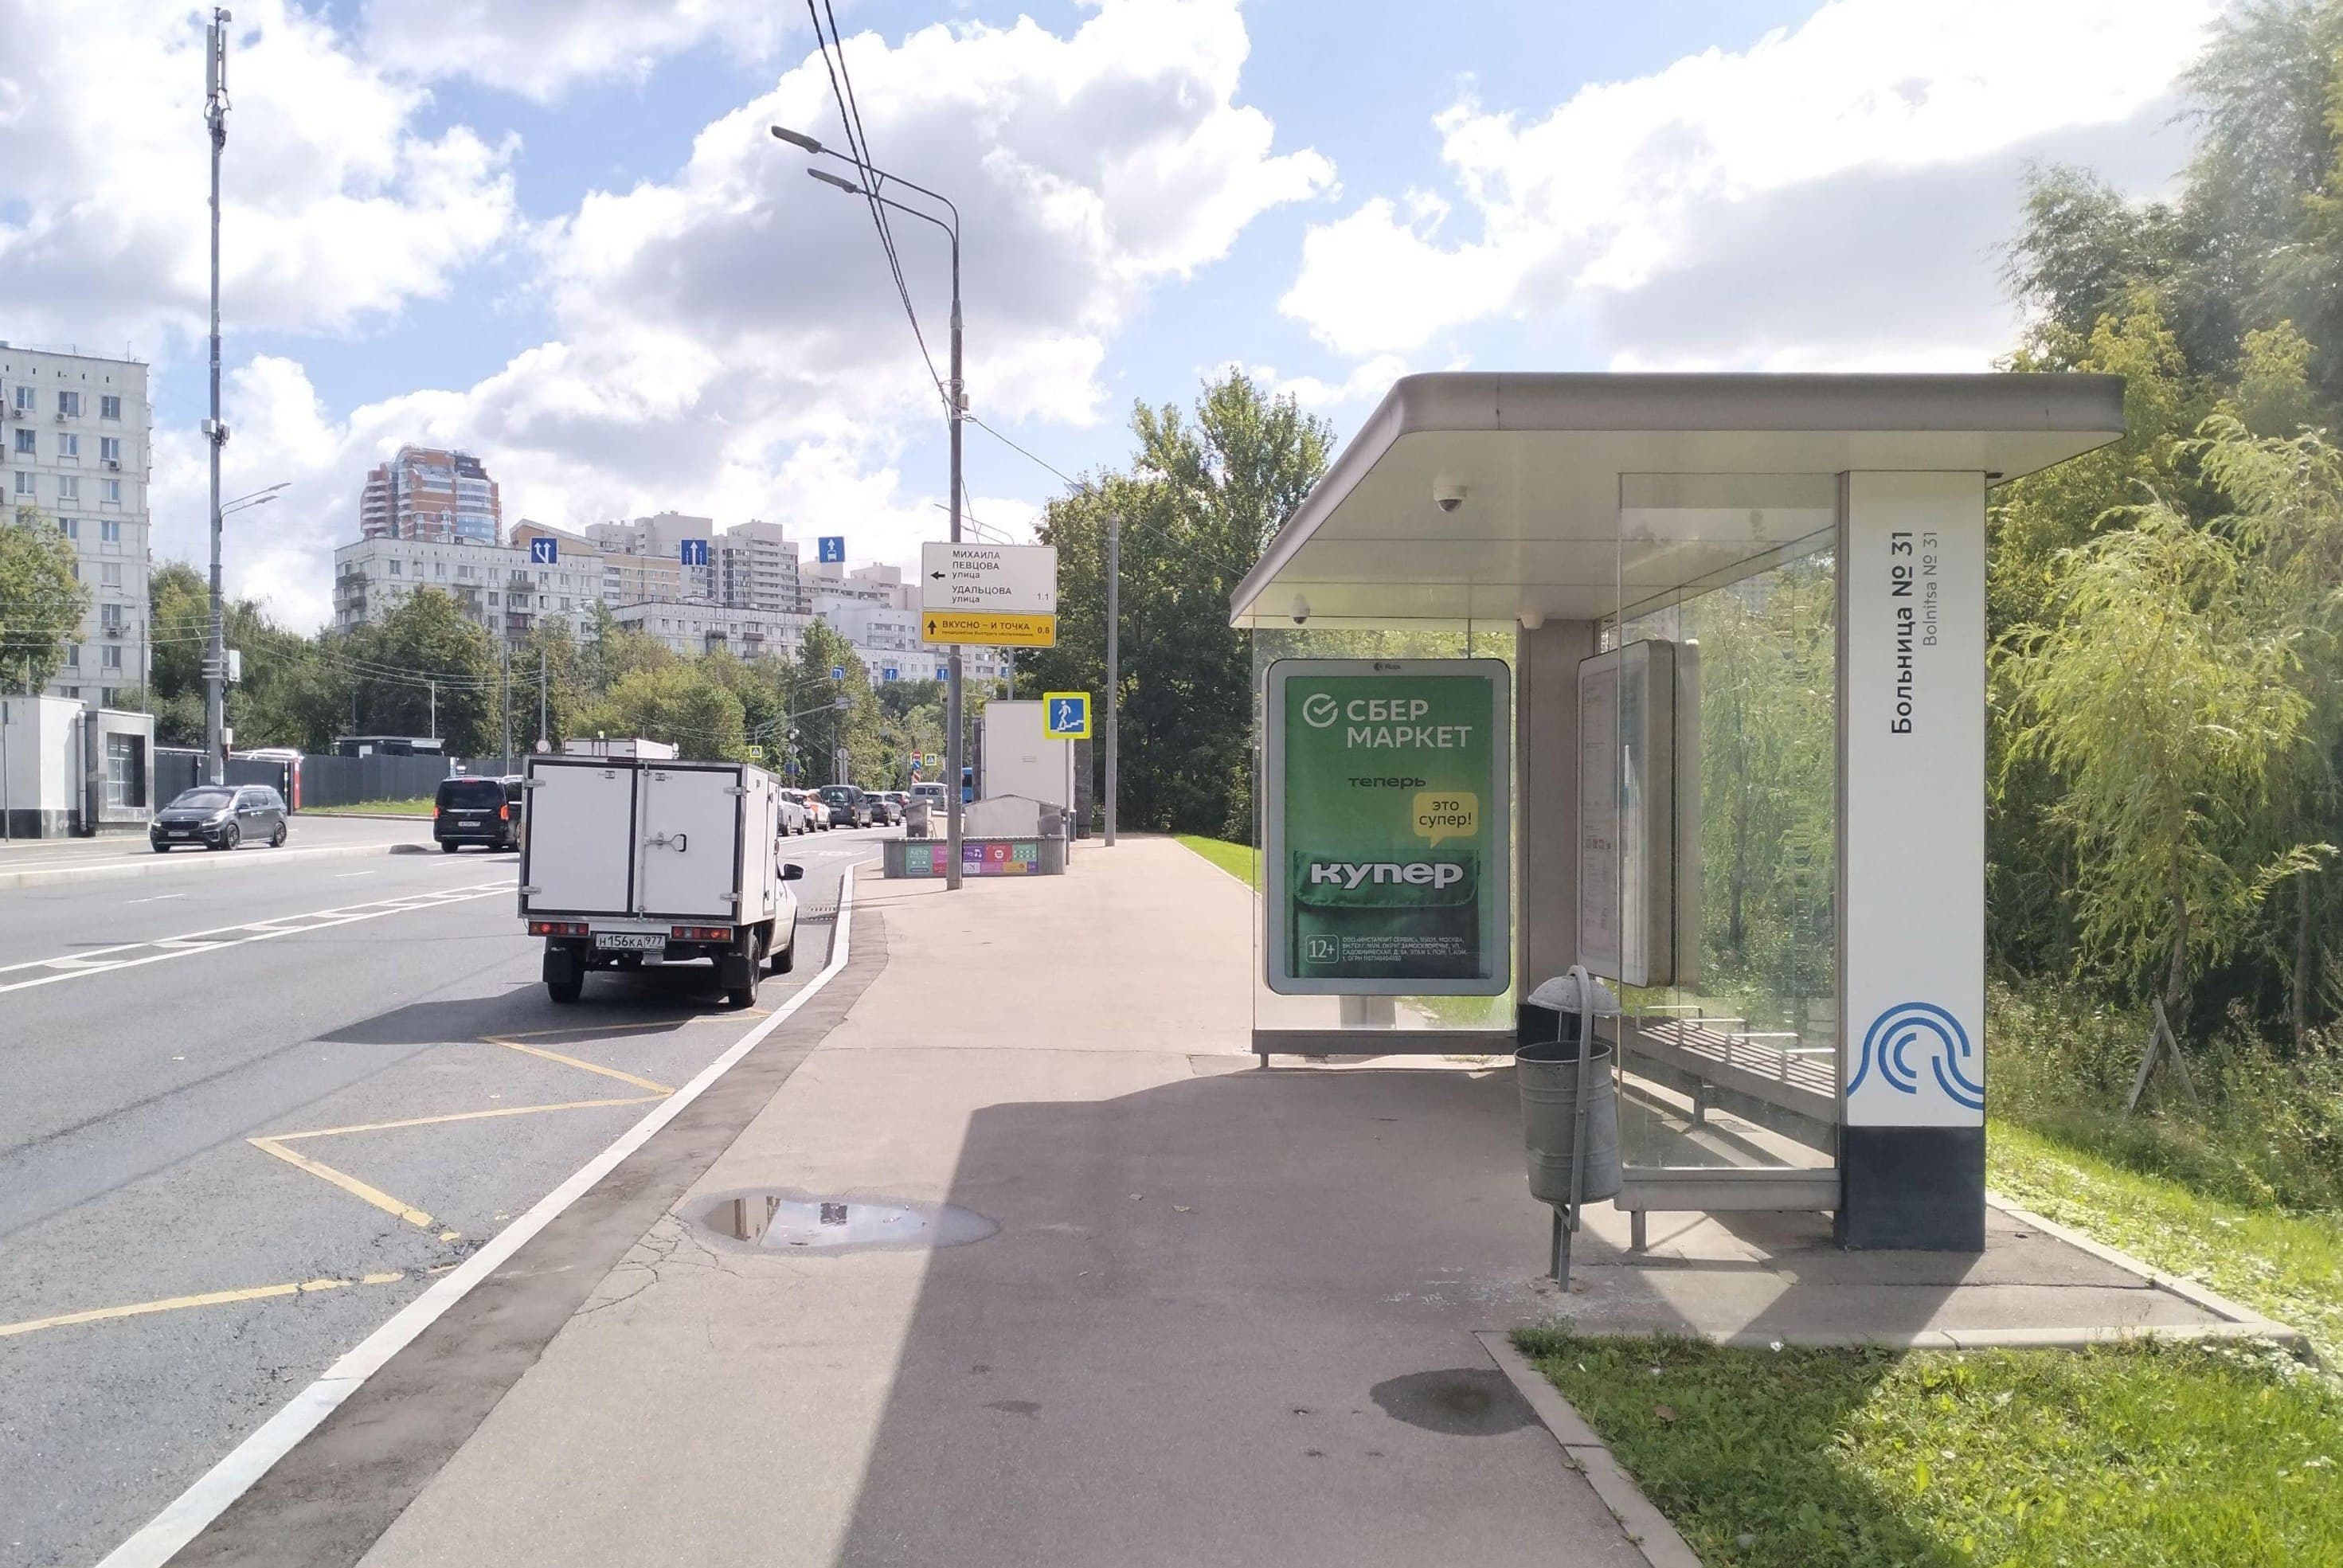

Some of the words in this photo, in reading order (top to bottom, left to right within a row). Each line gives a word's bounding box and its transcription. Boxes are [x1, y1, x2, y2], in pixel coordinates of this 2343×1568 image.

[1891, 532, 1913, 556] 31
[1923, 532, 1938, 548] 31
[952, 550, 1000, 560] МИХАИЛА
[952, 561, 1000, 571] ПЕВЦОВА
[1923, 554, 1938, 575] №
[952, 571, 980, 580] улица
[1891, 565, 1913, 596] №
[952, 585, 1011, 596] УДАЛЬЦОВА
[1923, 581, 1938, 646] Bolnitsa
[942, 620, 980, 629] ВКУСНО
[1000, 622, 1030, 631] ТОЧКА
[1891, 607, 1915, 733] Больница
[1347, 699, 1429, 721] СБЕР
[1347, 726, 1473, 748] МАРКЕТ
[1348, 776, 1426, 789] теперь
[1433, 801, 1459, 811] это
[1419, 812, 1472, 828] супер!
[1311, 862, 1464, 889] купер
[1308, 940, 1335, 958] 12+
